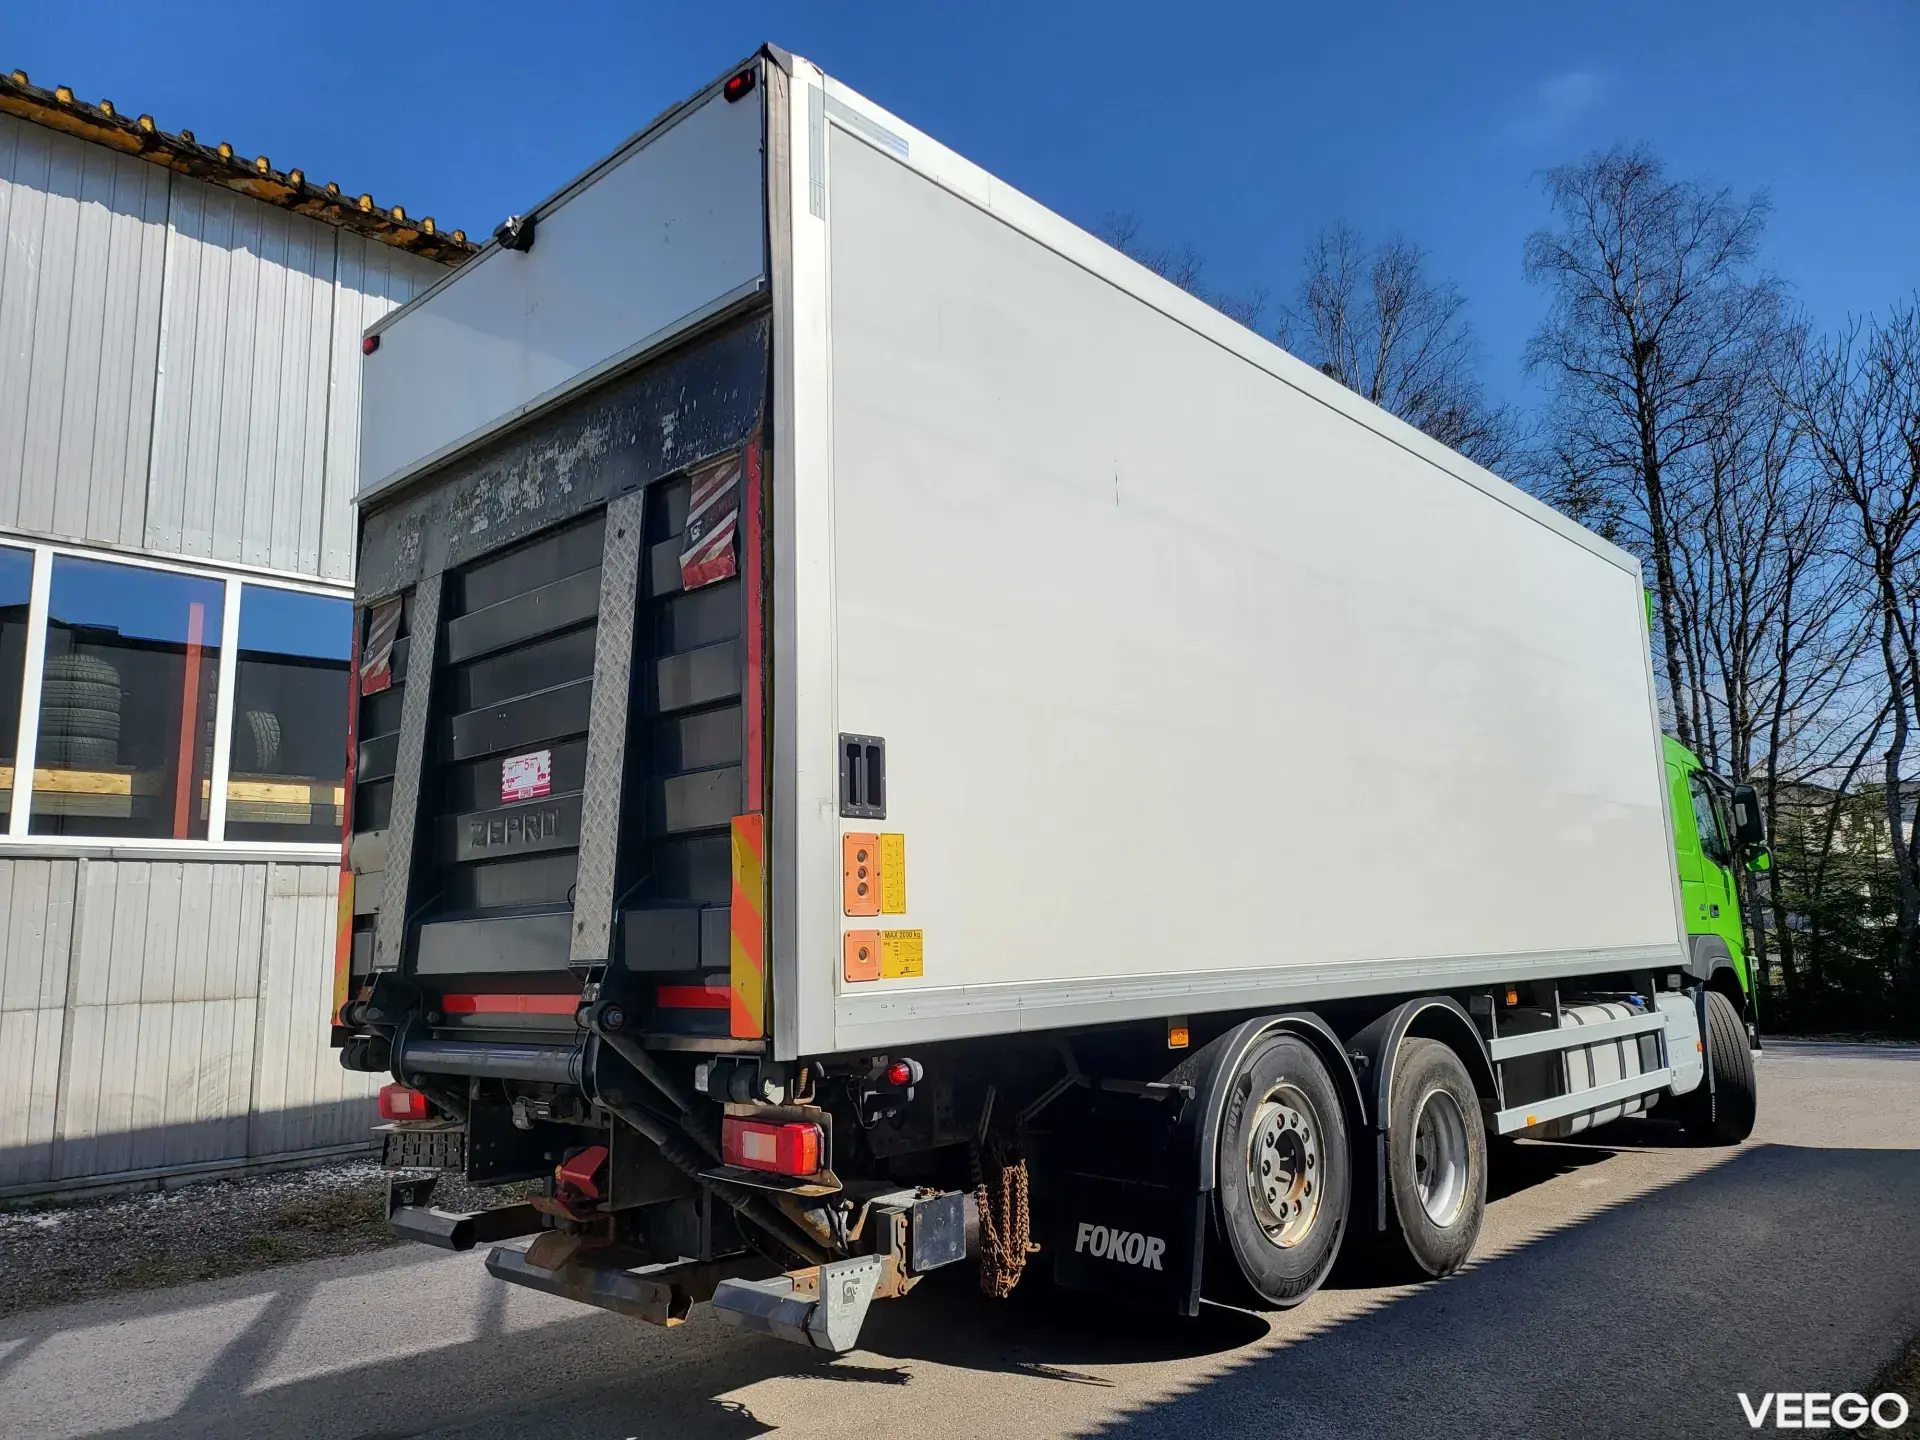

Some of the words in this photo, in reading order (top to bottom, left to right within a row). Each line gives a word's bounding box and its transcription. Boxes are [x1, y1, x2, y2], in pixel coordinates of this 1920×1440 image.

[470, 809, 560, 848] ZEPRO
[884, 931, 898, 939] MAX
[899, 931, 913, 939] 2000
[913, 931, 921, 939] kg
[1226, 1085, 1245, 1144] MULTI
[1075, 1221, 1166, 1271] FOKOR
[1273, 1250, 1329, 1297] MICHELI
